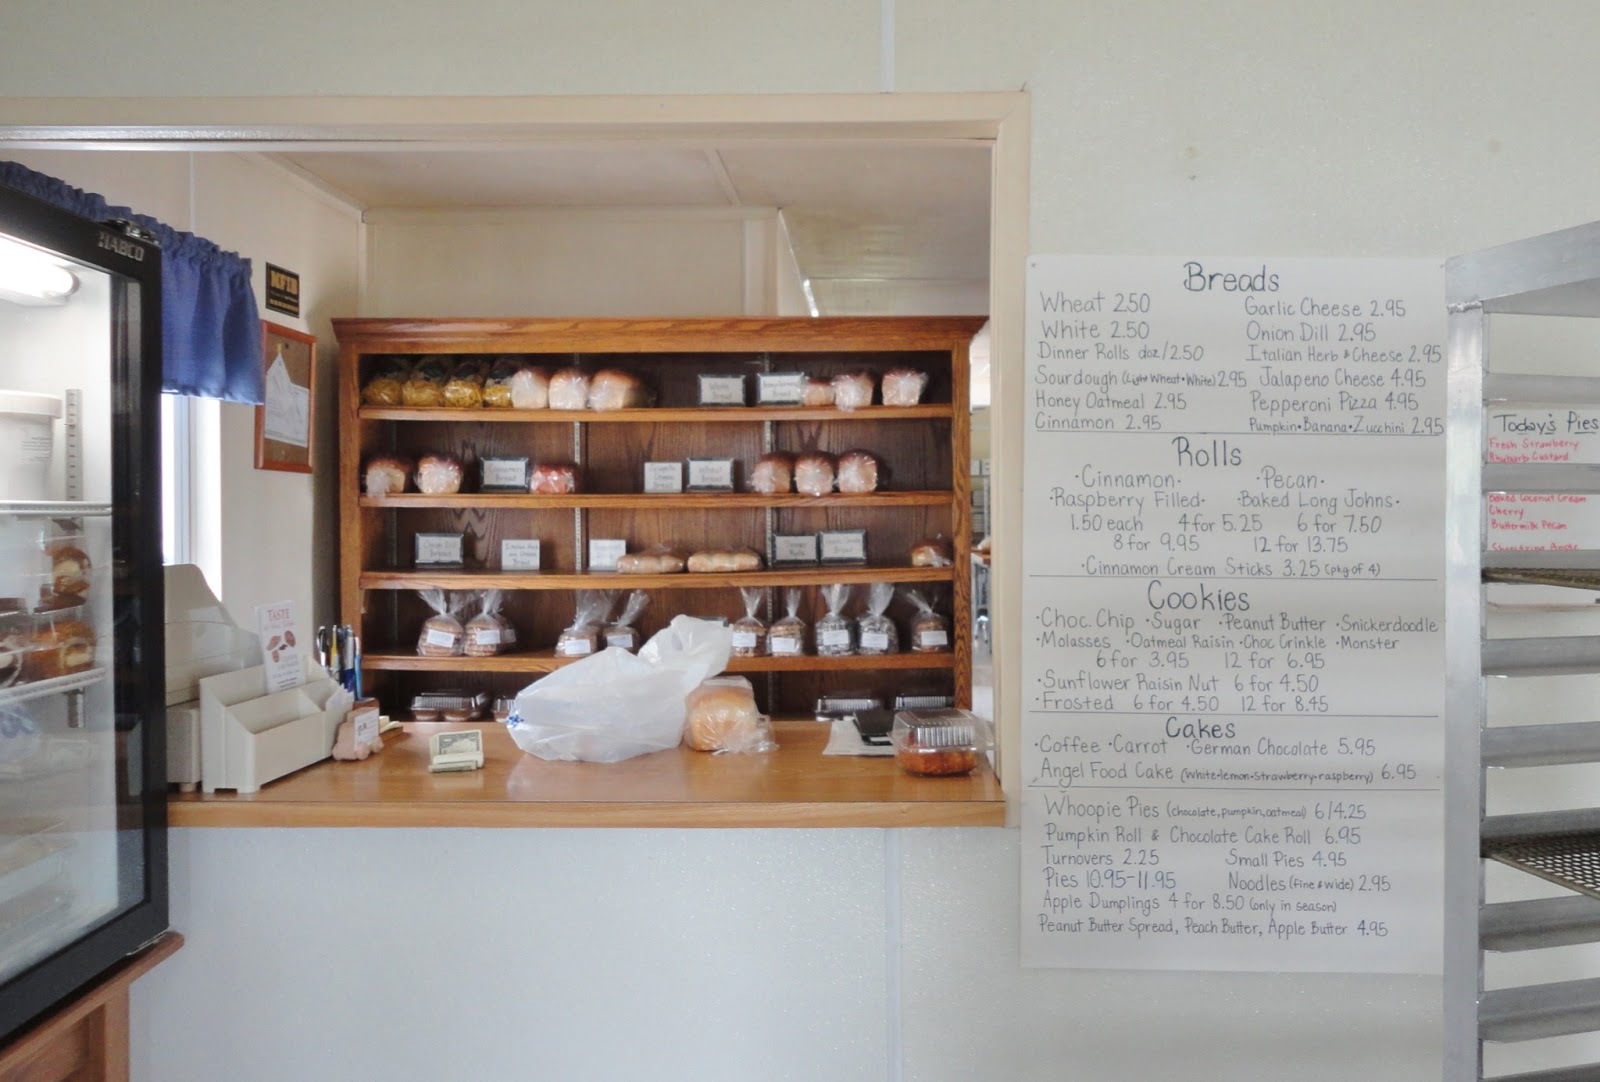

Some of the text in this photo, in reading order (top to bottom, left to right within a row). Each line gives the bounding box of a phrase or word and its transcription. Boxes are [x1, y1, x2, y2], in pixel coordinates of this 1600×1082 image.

[1183, 262, 1280, 291] Breads
[1040, 291, 1150, 312] Wheat 2.50
[1245, 296, 1406, 317] Garlic Cheese 2.95
[1041, 320, 1150, 339] White 2.50
[1246, 320, 1376, 342] Onion Dill 2.95
[1038, 341, 1089, 360] Dinner
[1094, 343, 1130, 360] Rolls
[1245, 344, 1441, 363] Italian Herb Cheese 2.95
[1034, 365, 1118, 393] Sourdough
[1218, 371, 1247, 388] 2.95
[1259, 366, 1426, 391] Jalapeno Cheese 4.95
[1035, 390, 1187, 417] Honey Oatmeal 2.95
[1250, 390, 1419, 417] Pepperoni Pizza 4.95
[1035, 411, 1162, 430] Cinnamon 2.95
[1411, 417, 1445, 434] 2.95
[1493, 411, 1599, 435] Today's Pies
[1171, 436, 1242, 467] Rolls
[1489, 438, 1579, 449] Fresh Strawberry
[1533, 453, 1568, 461] Custard
[1082, 464, 1175, 488] Cinnamon
[1051, 487, 1200, 516] Raspberry Filled
[1239, 490, 1289, 507] Baked
[1299, 492, 1337, 515] Long
[1489, 505, 1524, 520] Cherry
[1071, 514, 1143, 531] 1.50 each
[1178, 513, 1263, 532] 4 for 5.25
[1297, 513, 1382, 533] 6 for 7.50
[1491, 520, 1567, 530] Buttermilk Pecan
[1086, 555, 1381, 577] Cinnamon Cream Sticks 3.25 (pkg of 4)
[1148, 579, 1250, 611] Cookies
[1096, 609, 1134, 635] Chip
[1151, 611, 1200, 635] Sugar
[1222, 612, 1274, 631] Peanut
[1279, 612, 1325, 631] Butter
[1341, 614, 1439, 632] Snickerdoodle
[1041, 631, 1111, 648] Molasses
[1130, 632, 1186, 648] Oatmeal
[1192, 634, 1234, 648] Raisin
[1279, 634, 1326, 649] Crinkle
[1341, 635, 1399, 649] Monster
[1043, 668, 1319, 692] Sunflower Raisin Nut 6 for 4.50
[1043, 691, 1329, 712] Frosted 6 for 4.50 12 for 8.45
[1165, 716, 1236, 739] Cakes
[1039, 734, 1376, 756] Coffee Carrot German Chocolate 5.95
[1041, 757, 1084, 788] Angel
[1090, 761, 1127, 779] Food
[1135, 762, 1173, 779] Cake
[1381, 763, 1416, 780] 6.95
[1044, 794, 1121, 823] Whoopie
[1126, 795, 1159, 818] Pies
[1045, 823, 1361, 849] Pumpkin Roll & Chocolate Cake Roll 6.95
[1041, 845, 1159, 866] Turnovers 2.25
[1225, 848, 1347, 867] Small Pies 4.95
[1042, 866, 1078, 888] Pies
[1228, 871, 1286, 891] Noodles
[1358, 875, 1391, 892] 2.95
[1043, 890, 1337, 919] Apple Dumplings 4 for 8.50 (only in season)
[1038, 913, 1388, 940] Peanut Butter Spread, Peach Butter, Apple Butter 4.95
